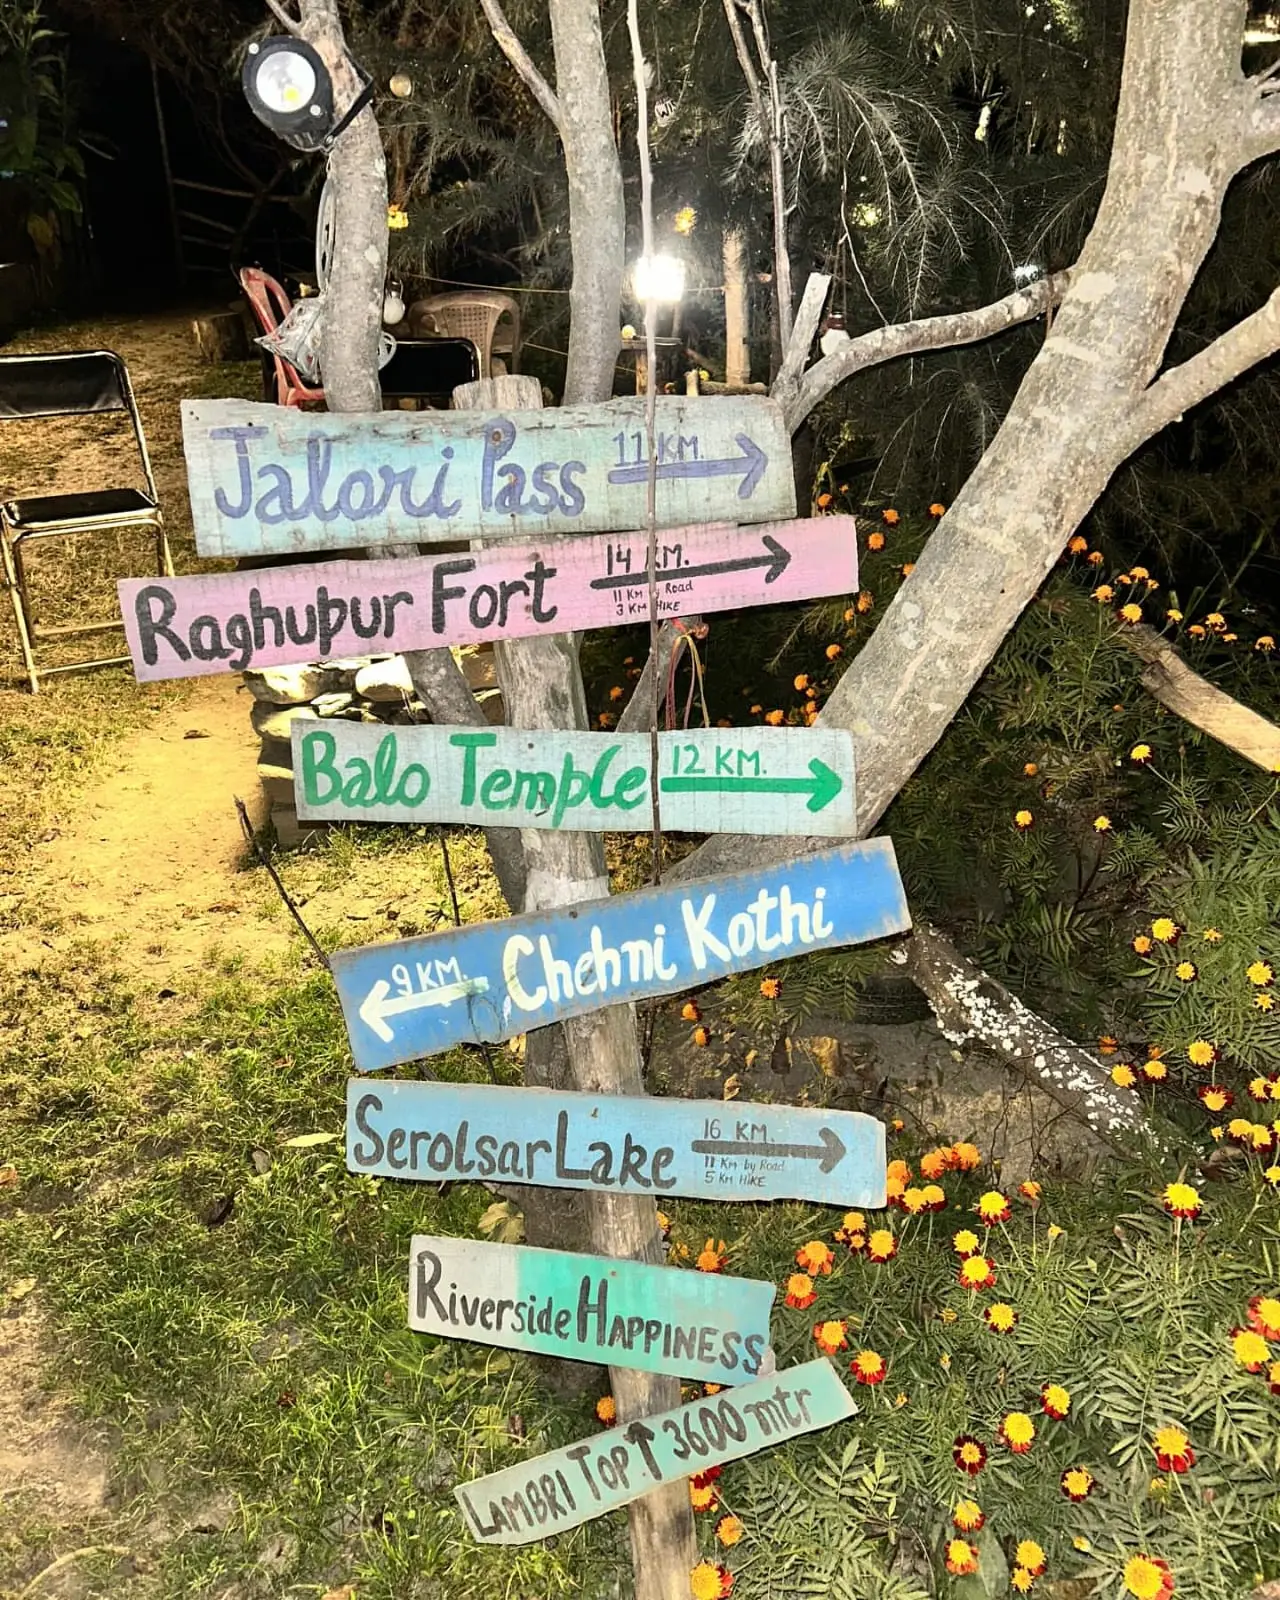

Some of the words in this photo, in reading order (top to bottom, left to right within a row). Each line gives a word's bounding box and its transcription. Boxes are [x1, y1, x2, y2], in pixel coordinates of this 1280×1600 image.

[613, 431, 649, 467] 11
[659, 432, 704, 463] KM.
[209, 426, 461, 524] Jalori
[481, 418, 587, 516] Pass
[607, 544, 631, 575] 14
[613, 590, 622, 602] 11
[665, 580, 693, 594] Road
[616, 604, 624, 615] 3
[656, 601, 681, 611] HIKE
[135, 585, 414, 669] Raghupur
[432, 559, 557, 633] Fort
[301, 730, 430, 808] Balo
[449, 733, 647, 828] Temple
[673, 744, 706, 775] 12
[715, 745, 767, 776] KM.
[502, 924, 678, 1011] Chehni
[681, 885, 834, 970] Kothi
[391, 963, 413, 997] 9
[416, 956, 468, 992] KM.
[354, 1095, 552, 1179] Serolsar
[555, 1110, 677, 1189] Lake
[704, 1118, 721, 1139] 16
[735, 1120, 775, 1142] KM.
[705, 1155, 715, 1167] 11
[743, 1158, 756, 1172] by
[760, 1160, 785, 1172] Road
[705, 1171, 715, 1184] 5
[415, 1250, 570, 1339] Riverside
[462, 1467, 577, 1537] LAMBRI
[662, 1398, 747, 1460] 3600
[743, 1385, 812, 1435] mtr
